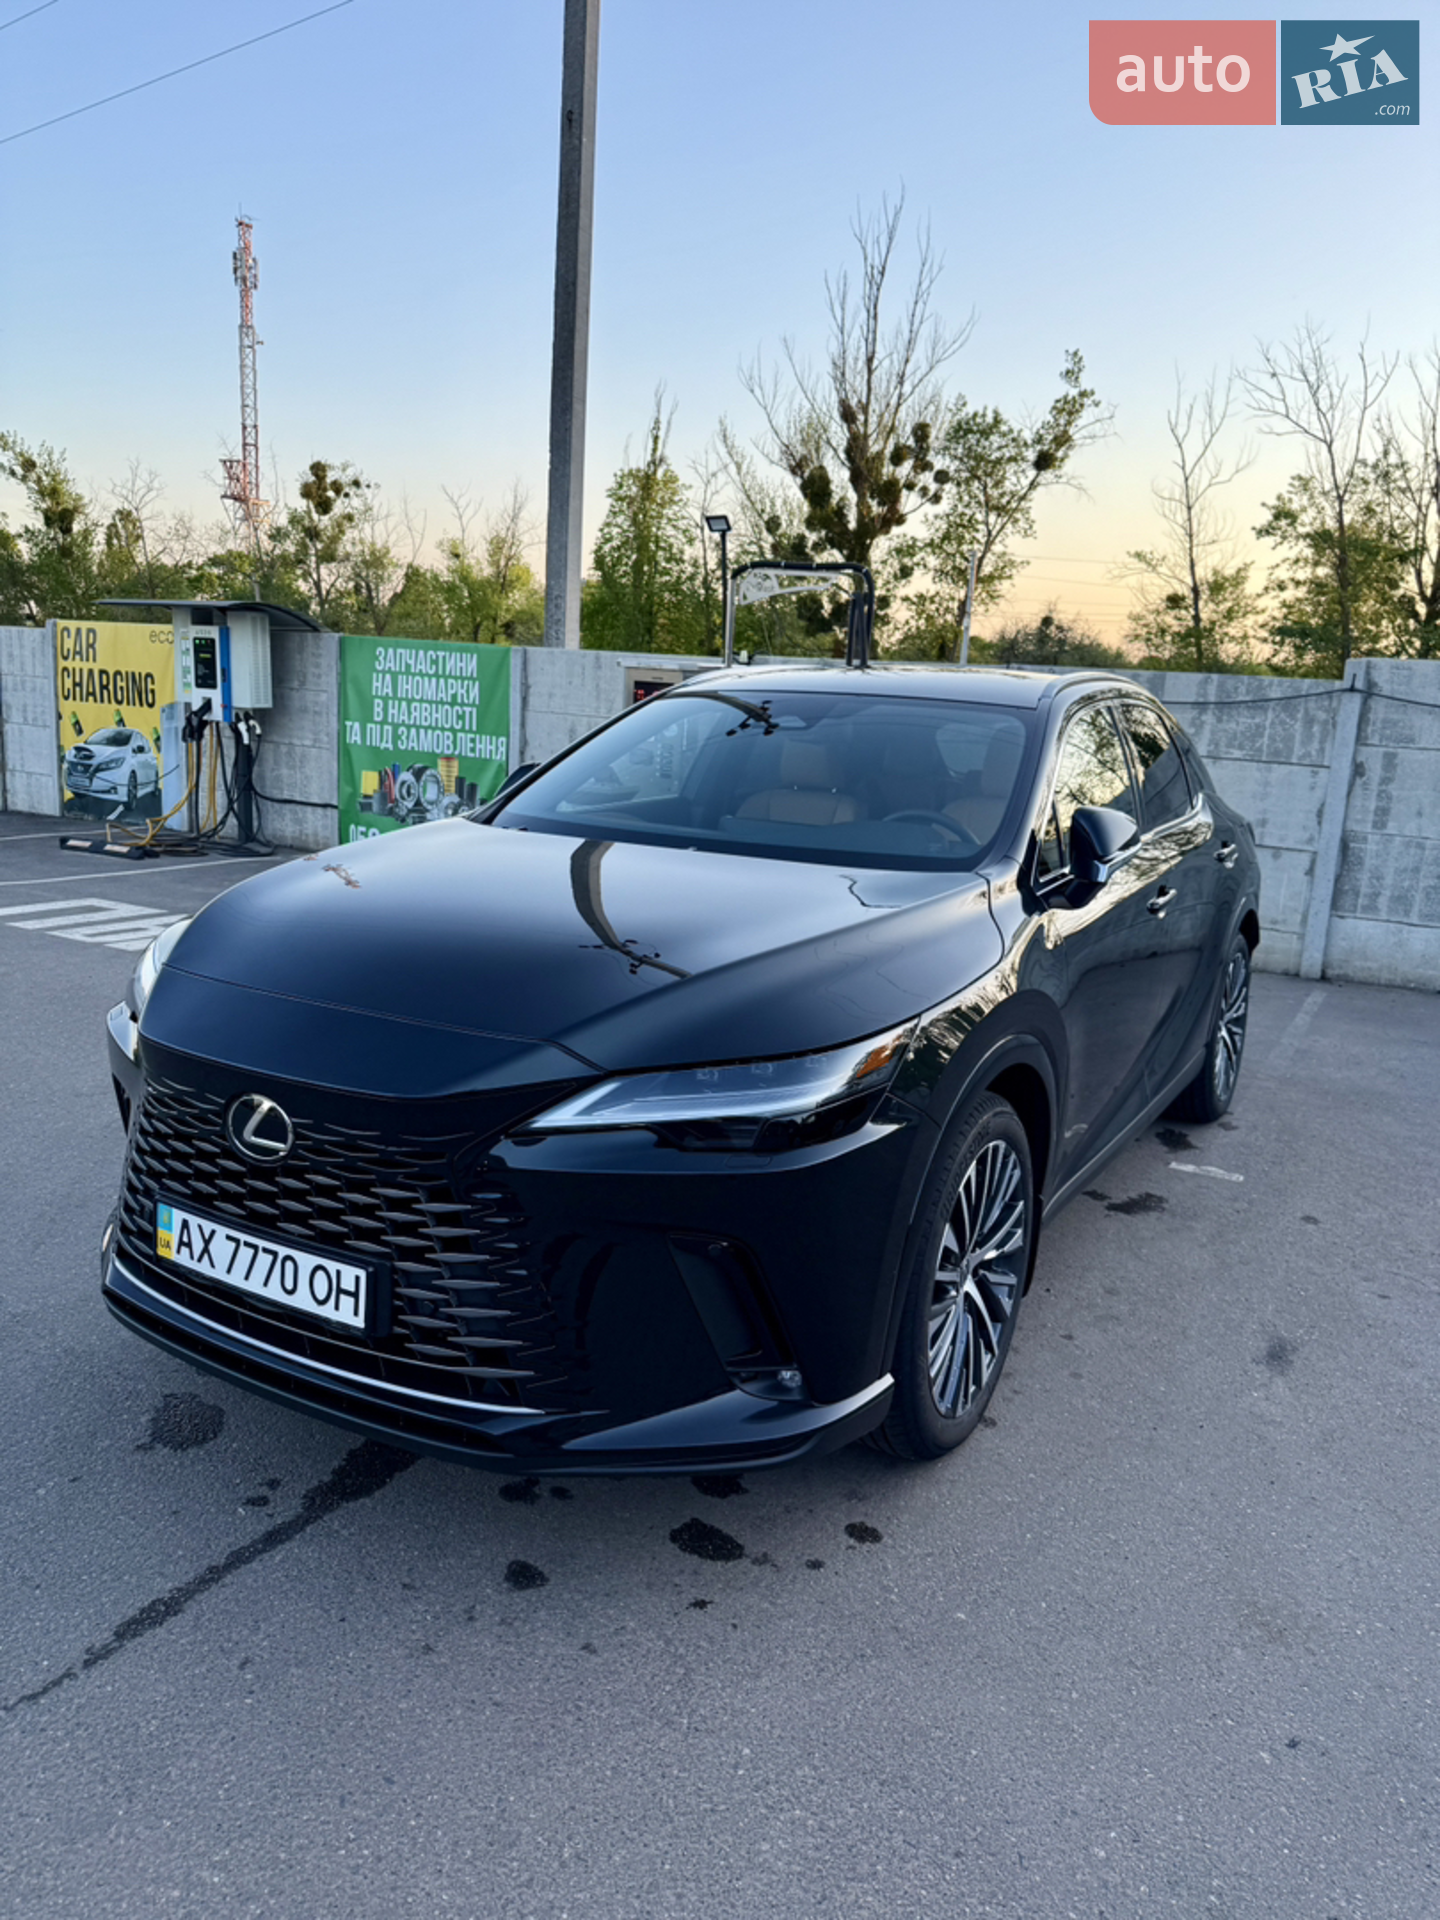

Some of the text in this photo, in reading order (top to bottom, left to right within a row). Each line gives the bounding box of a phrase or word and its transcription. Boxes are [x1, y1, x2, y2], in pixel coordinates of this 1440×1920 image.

[60, 626, 98, 663] CAR
[375, 646, 478, 678] ЗАПЧАСТИНИ
[60, 666, 156, 709] CHARGING
[372, 672, 480, 705] НА ІНОМАРКИ
[373, 698, 478, 732] В НАЯВНОСТІ
[345, 720, 507, 761] ТА ПІД ЗАМОВЛЕННЯ
[159, 1237, 172, 1250] UA
[175, 1217, 361, 1318] AX 7770 OH
